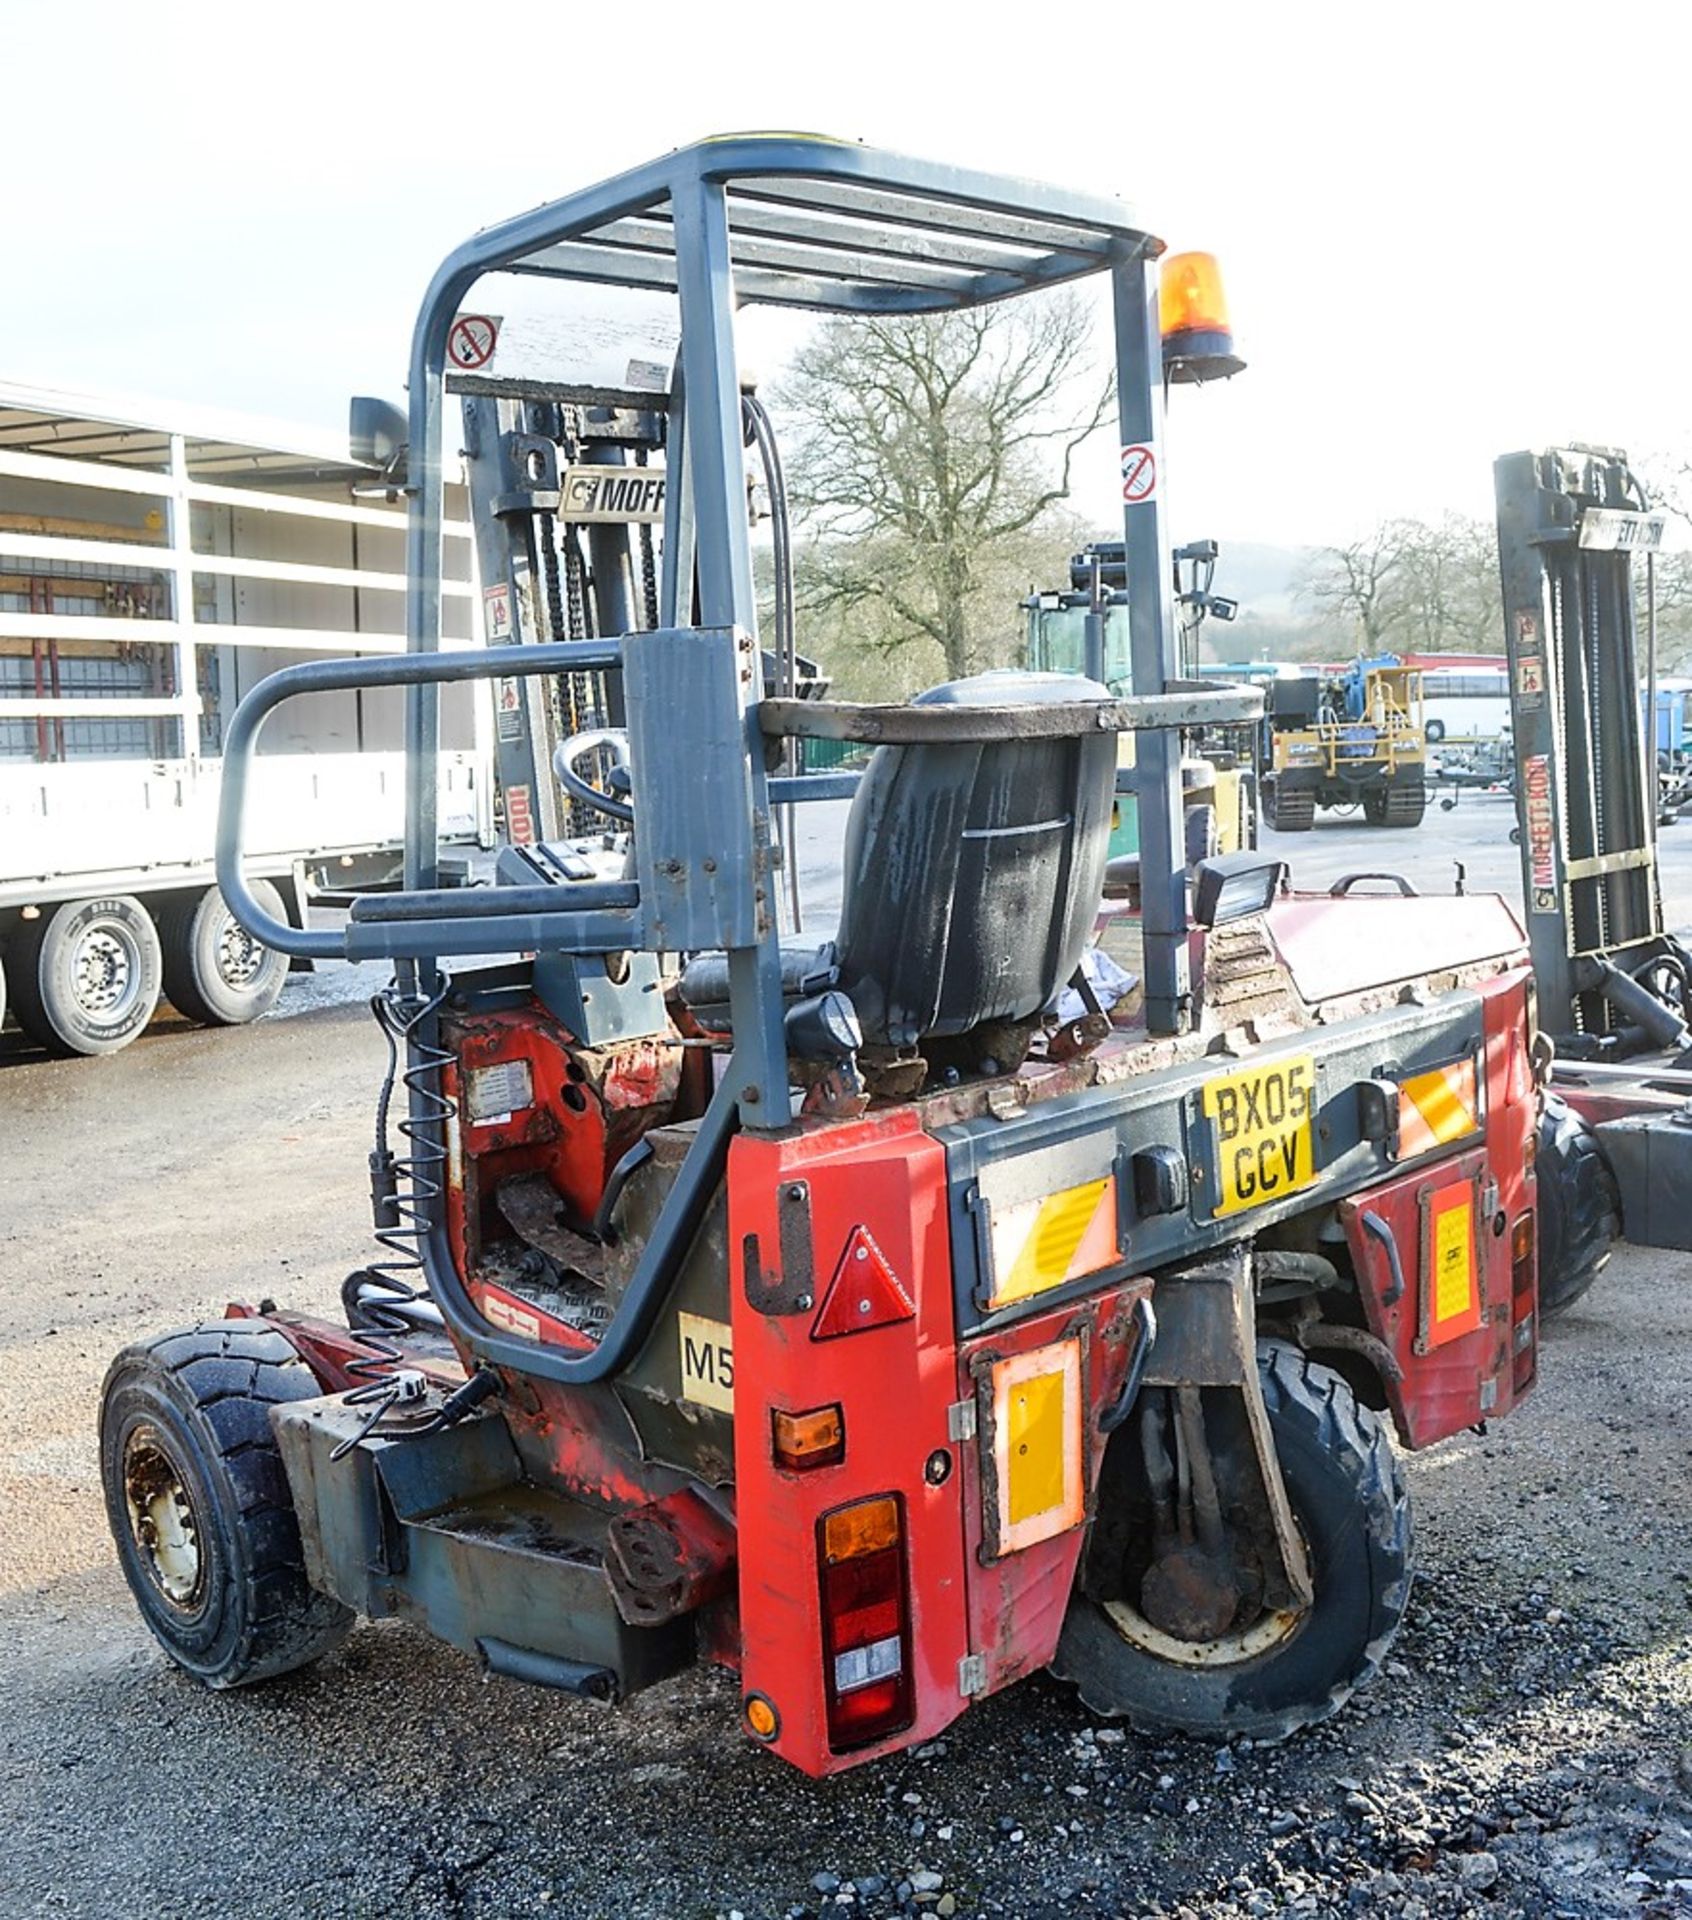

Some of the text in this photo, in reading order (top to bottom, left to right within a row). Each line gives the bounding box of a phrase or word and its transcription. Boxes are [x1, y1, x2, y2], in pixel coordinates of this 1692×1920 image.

[1216, 1065, 1307, 1142] BX05
[1234, 1131, 1298, 1199] GCV
[685, 1336, 734, 1389] M5
